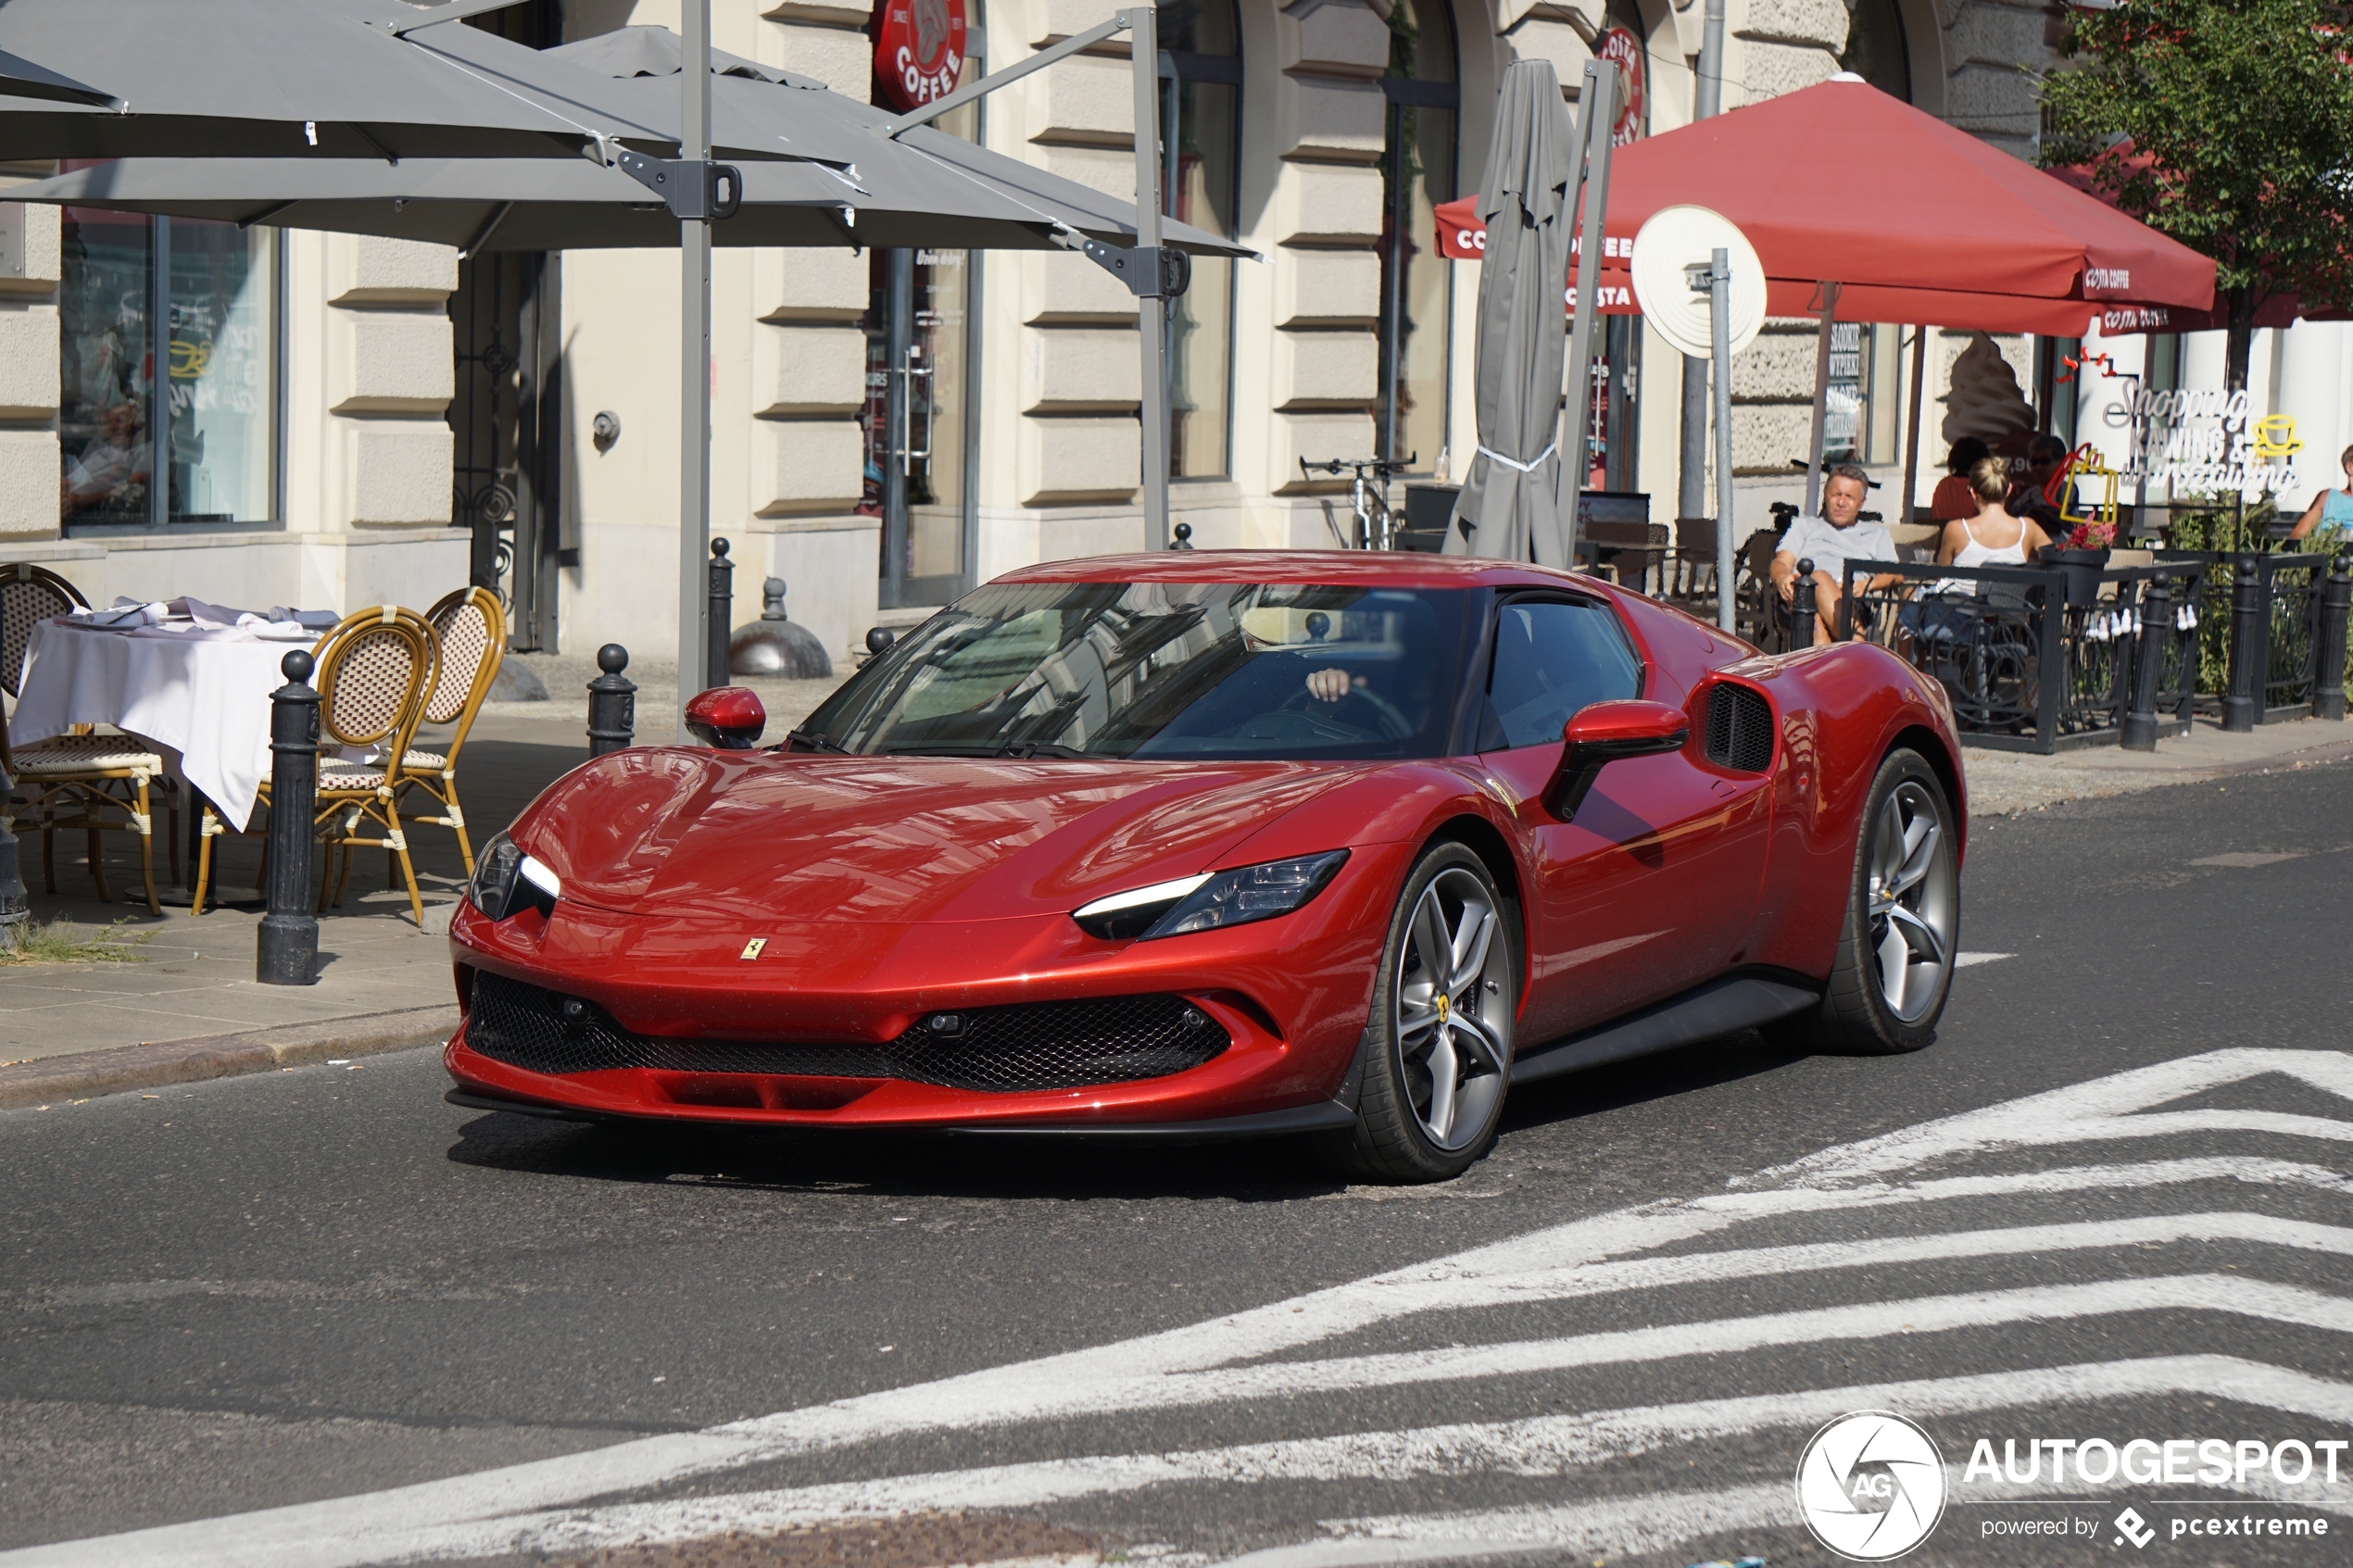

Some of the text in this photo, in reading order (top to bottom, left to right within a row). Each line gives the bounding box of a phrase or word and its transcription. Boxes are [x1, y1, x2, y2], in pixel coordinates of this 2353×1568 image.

[897, 45, 961, 103] COFFEE
[1565, 287, 1630, 307] CSTA
[2085, 268, 2130, 290] COSTA COFFEE
[2105, 310, 2137, 331] COSTA
[2103, 377, 2254, 433] Shopping
[2131, 426, 2247, 463] KAWING &
[2120, 462, 2300, 504] warszawing
